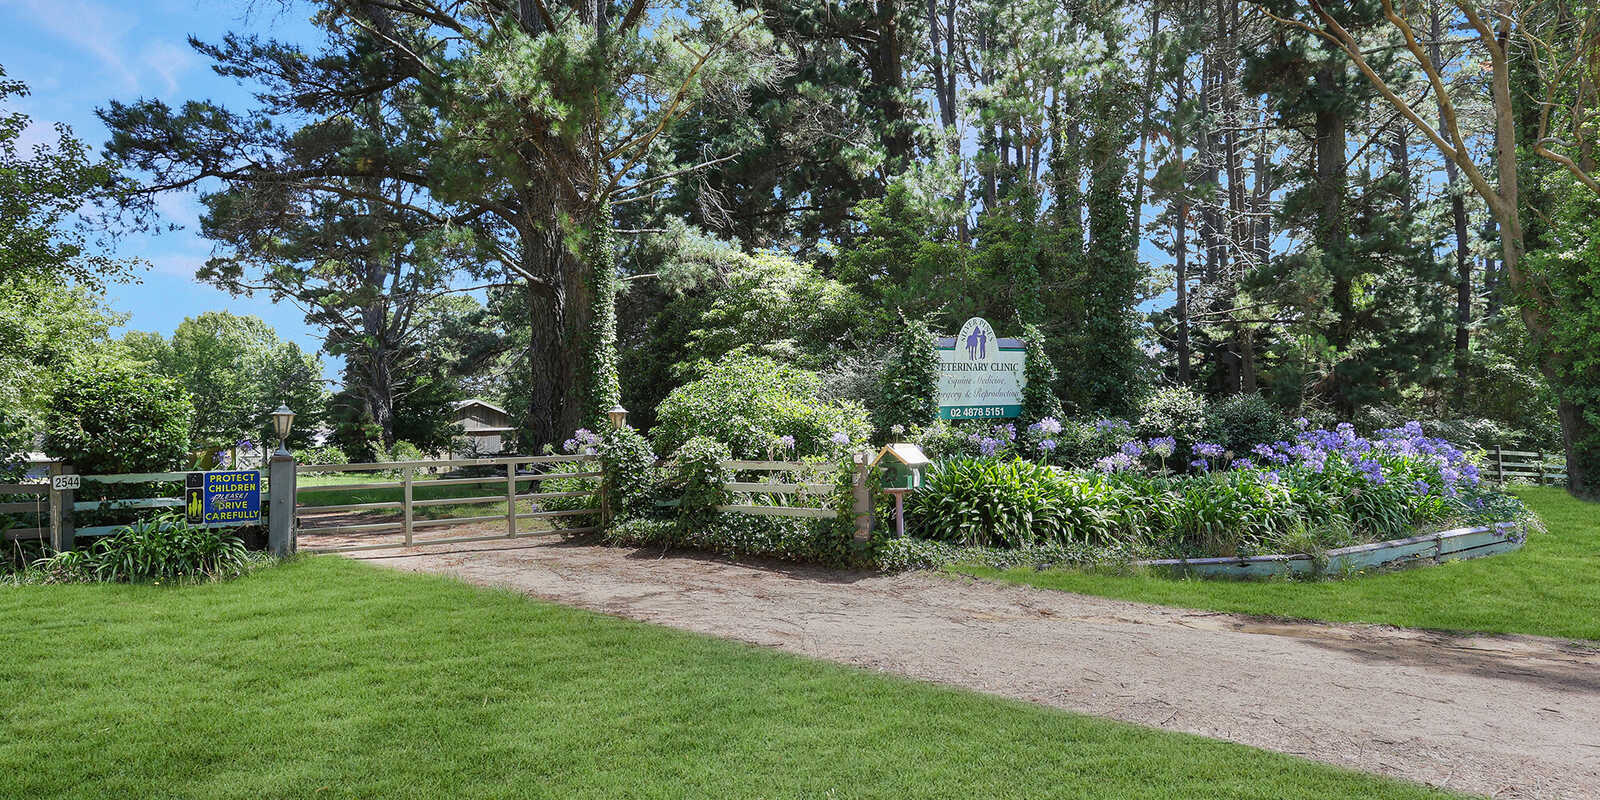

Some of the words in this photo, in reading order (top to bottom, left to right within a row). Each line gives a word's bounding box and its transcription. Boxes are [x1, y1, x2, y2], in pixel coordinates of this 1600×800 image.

[961, 319, 977, 342] SILVER
[990, 362, 1019, 372] CLINIC
[948, 376, 971, 388] Equine
[938, 390, 962, 400] urgery
[950, 408, 962, 417] 02
[963, 408, 984, 416] 4878
[985, 408, 1004, 416] 5151
[56, 478, 80, 488] 2544
[210, 474, 255, 482] PROTECT
[208, 484, 256, 492] CHILDREN
[218, 501, 248, 510] DRIVE
[206, 510, 258, 520] CAREFULLY
